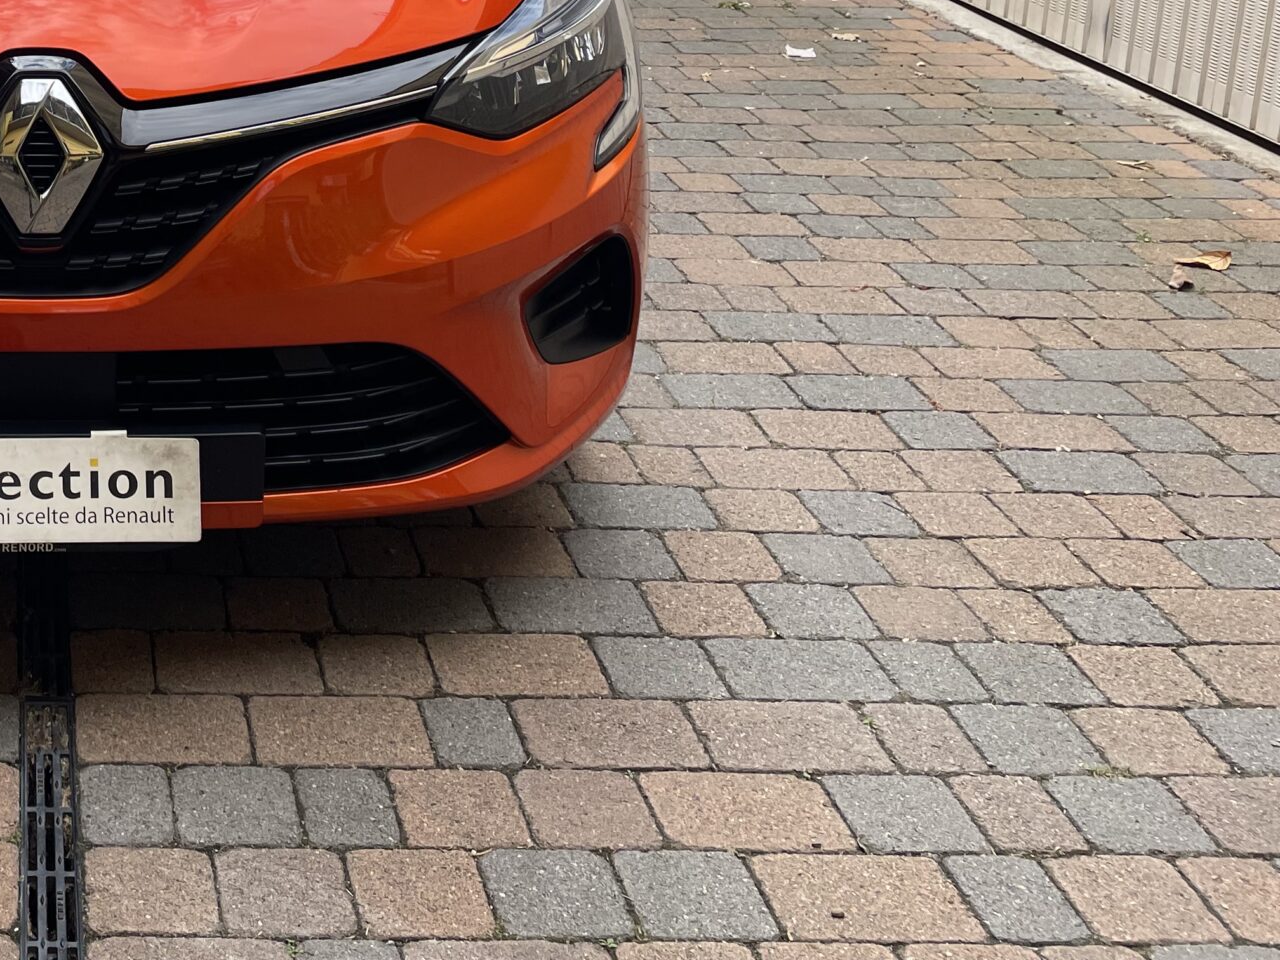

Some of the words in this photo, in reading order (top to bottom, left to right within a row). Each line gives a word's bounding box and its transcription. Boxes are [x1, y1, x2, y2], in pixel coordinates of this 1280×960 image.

[16, 506, 70, 525] scelte
[75, 506, 98, 524] da
[103, 505, 175, 524] Renault
